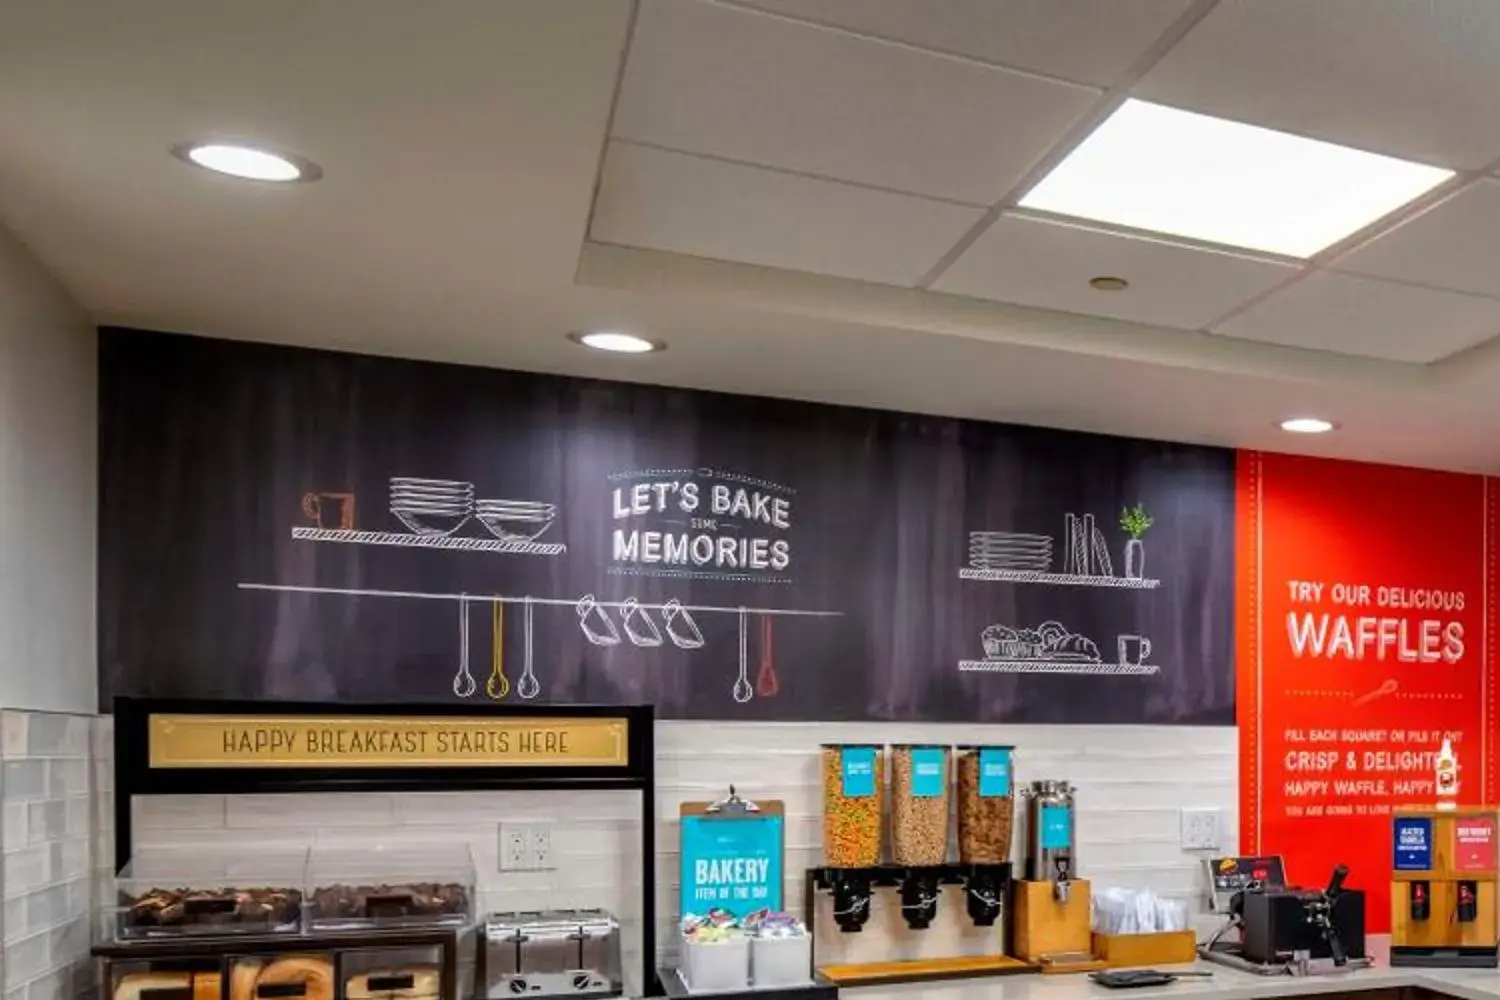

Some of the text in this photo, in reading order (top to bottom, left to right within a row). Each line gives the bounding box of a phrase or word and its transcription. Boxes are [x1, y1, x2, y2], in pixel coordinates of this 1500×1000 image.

[613, 481, 791, 529] LET'S BAKE
[613, 529, 790, 570] MEMORIES
[1288, 580, 1465, 611] TRY OUR DELICIOUS
[1286, 611, 1465, 664] WAFFLES
[223, 729, 569, 753] HAPPY BREAKFAST STARTS HERE
[1309, 729, 1337, 742] EACH
[1285, 751, 1339, 771] CRISP
[1346, 752, 1357, 771] &
[1285, 780, 1329, 797] HAPPY
[1393, 780, 1434, 796] HAPPY
[695, 857, 769, 885] BAKERY
